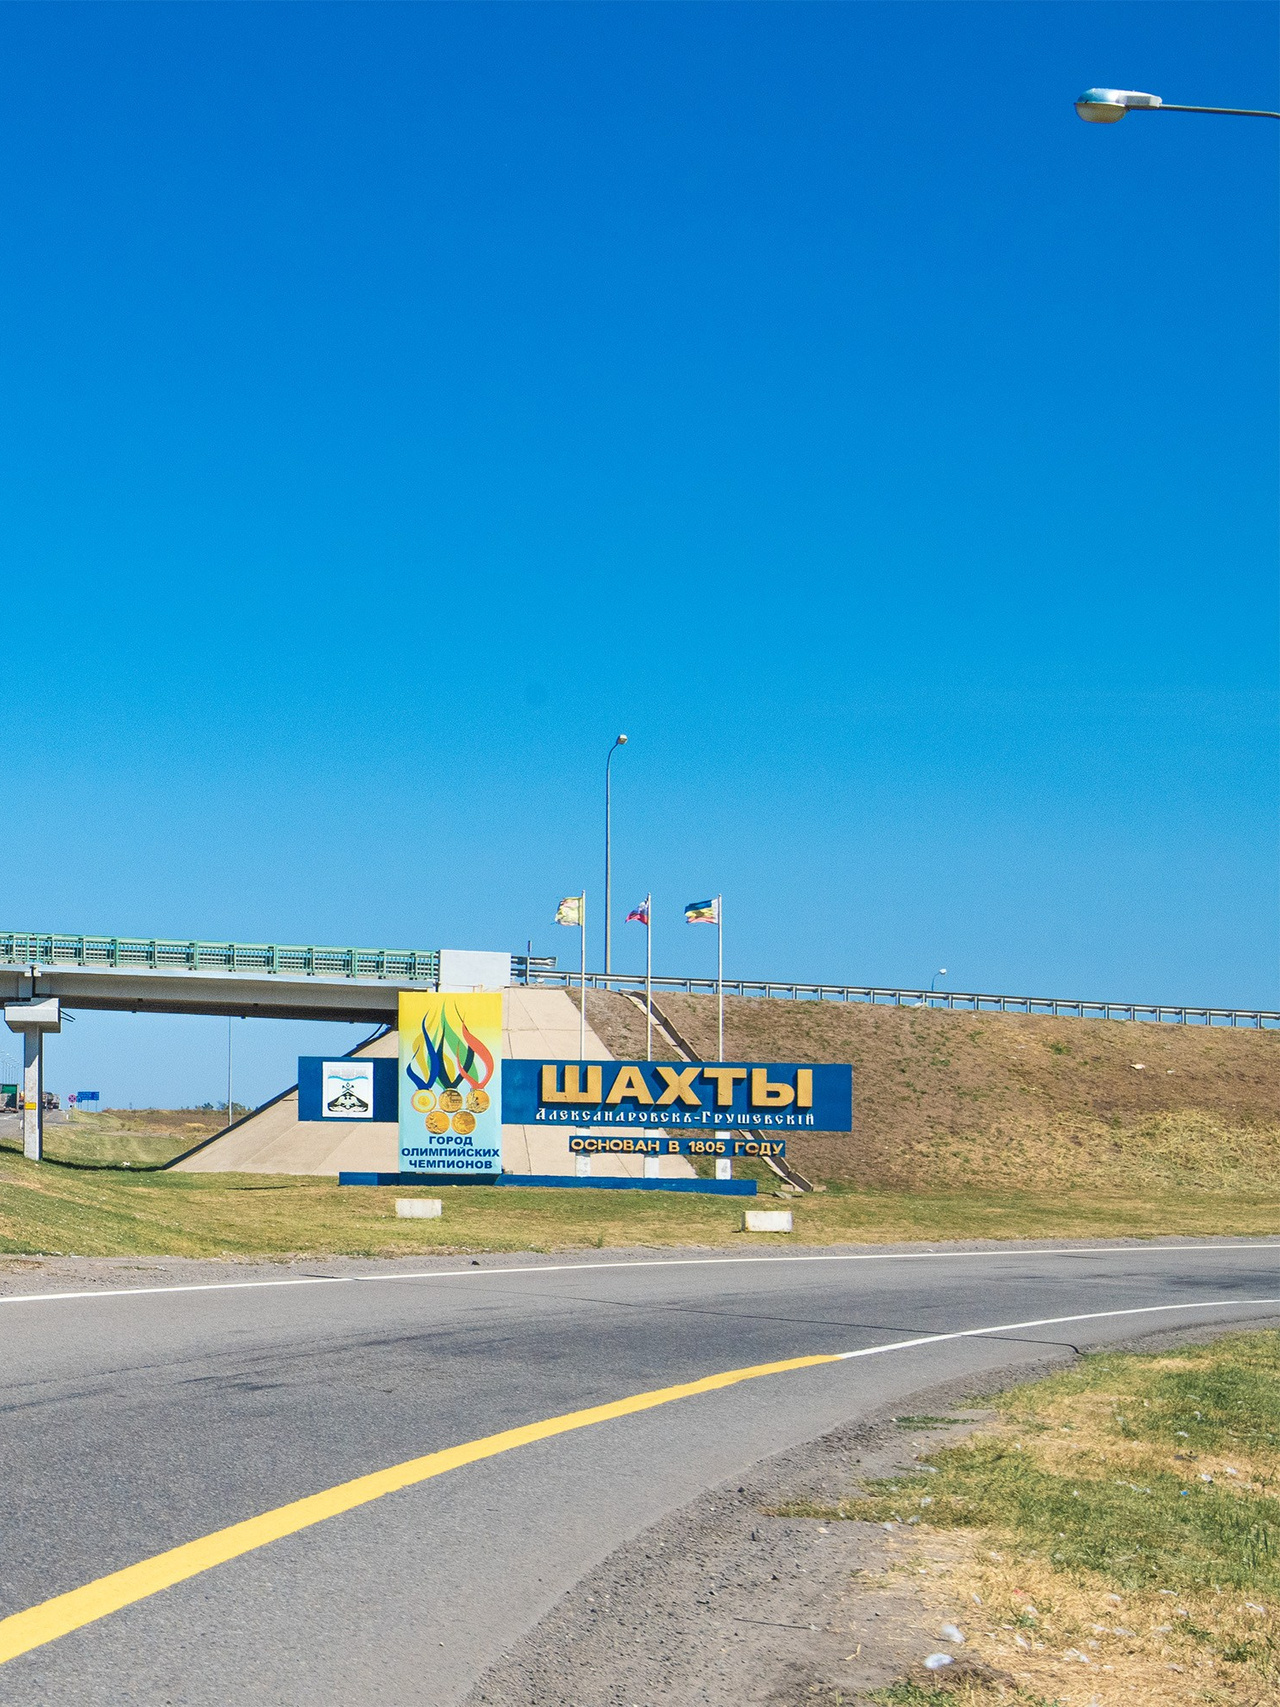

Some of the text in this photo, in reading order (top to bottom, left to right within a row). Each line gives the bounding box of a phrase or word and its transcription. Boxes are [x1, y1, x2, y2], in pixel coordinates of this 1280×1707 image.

[541, 1064, 813, 1107] ШАХТЫ
[429, 1136, 473, 1147] ГОРОД
[571, 1138, 784, 1156] ОСНОВАН В 1805 ГОДУ
[401, 1147, 500, 1158] ОЛИМПИЙСКИХ
[409, 1159, 493, 1169] ЧЕМПИОНОВ
